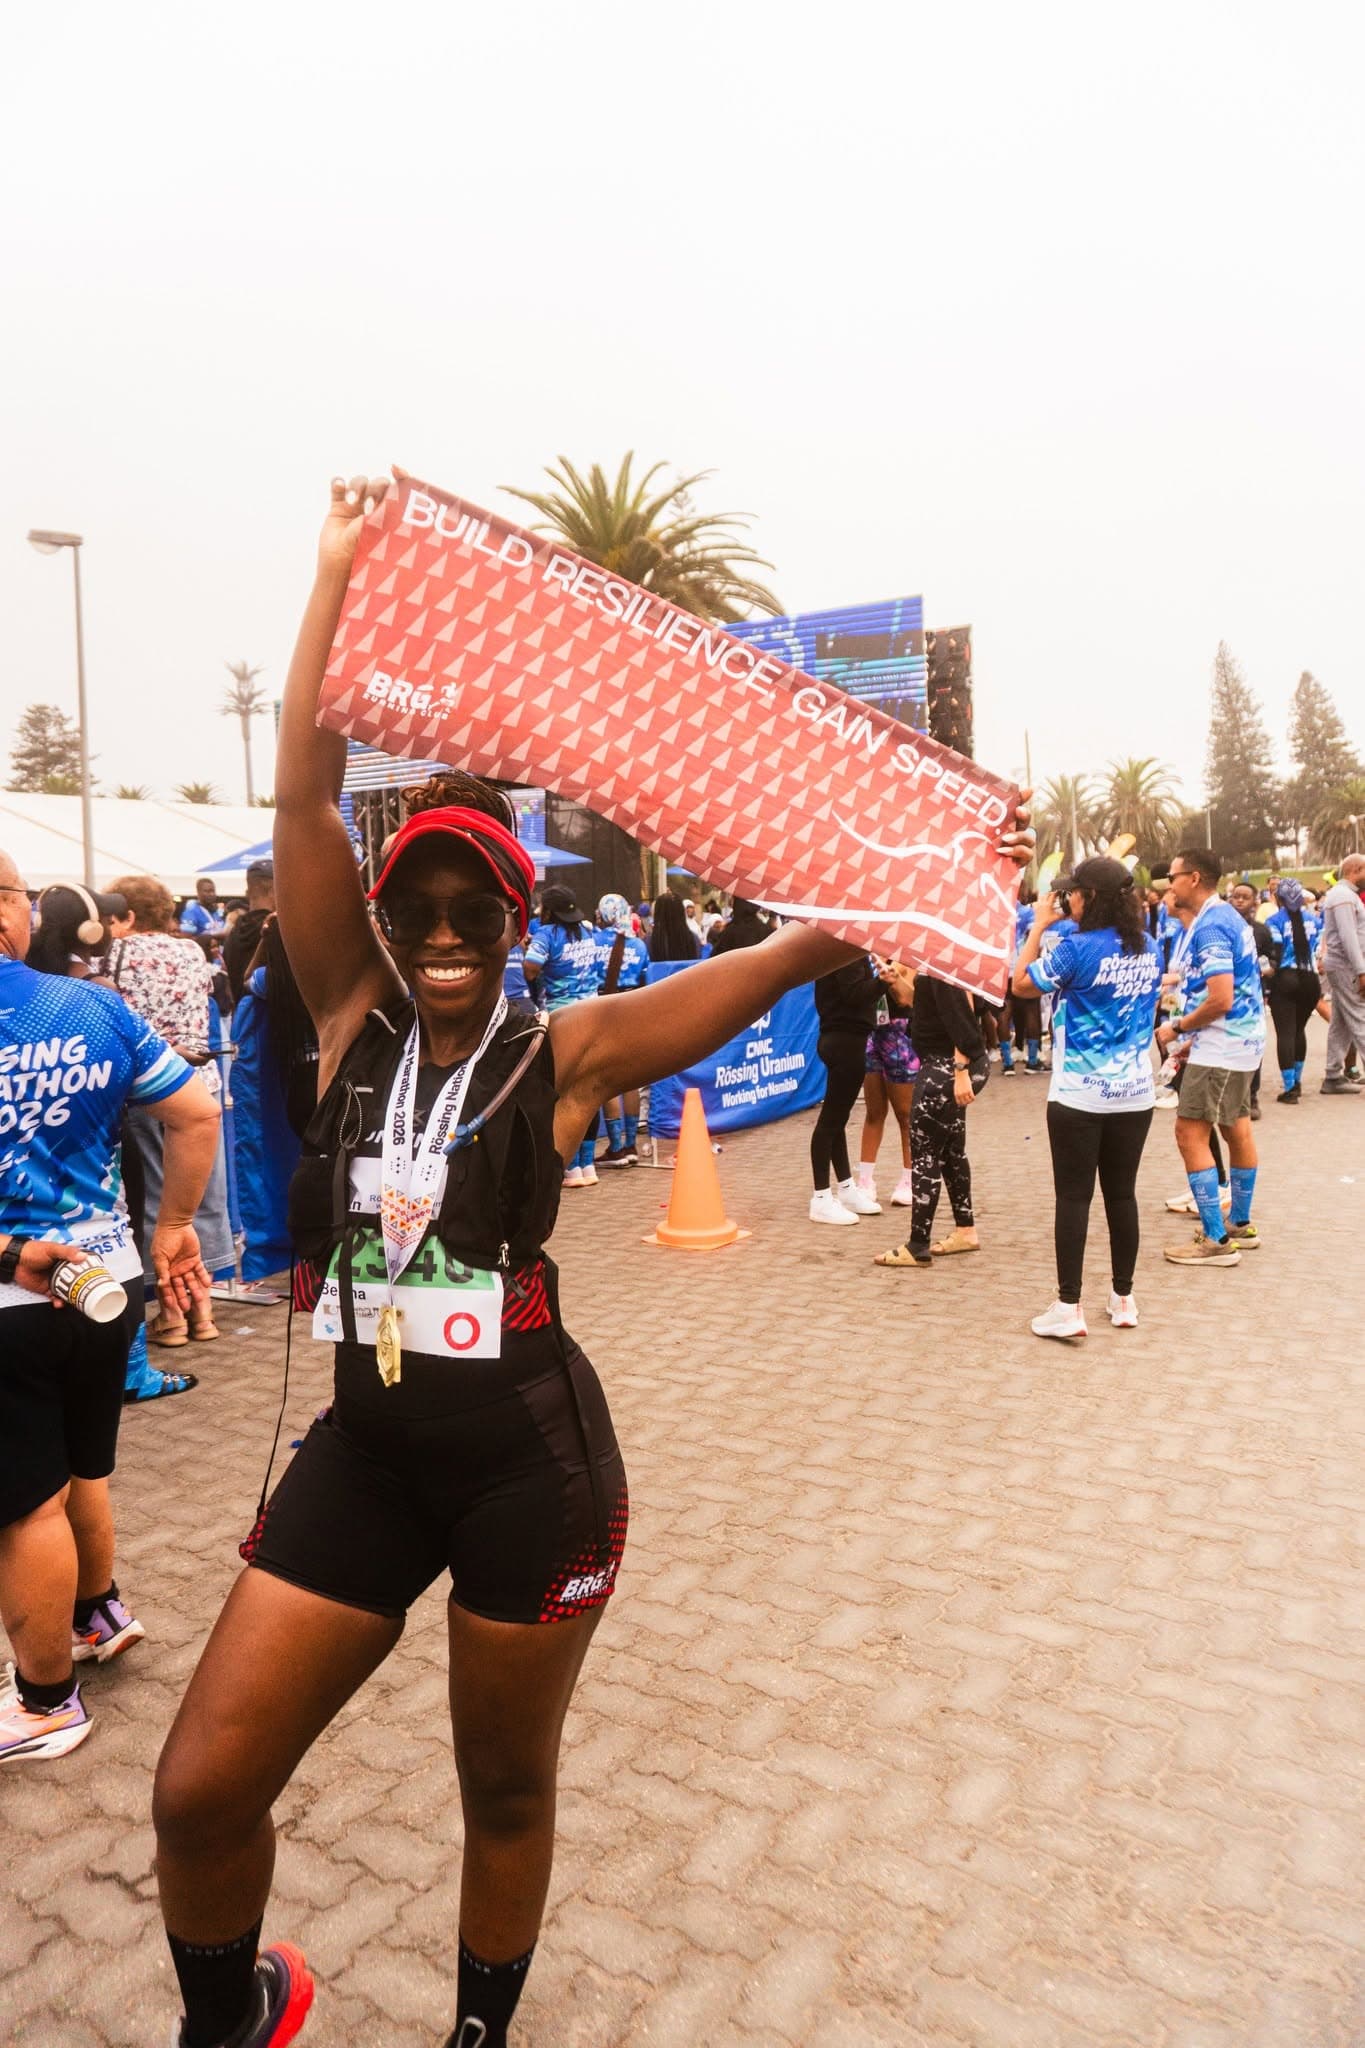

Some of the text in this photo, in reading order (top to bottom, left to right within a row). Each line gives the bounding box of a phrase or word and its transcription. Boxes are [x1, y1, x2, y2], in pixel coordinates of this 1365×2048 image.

[402, 488, 1008, 837] BUILD RESILIENCE. GAIN SPEED.
[362, 692, 450, 720] RUNNING CLUB
[366, 670, 435, 710] BRG
[1112, 979, 1153, 999] 2026
[396, 1056, 416, 1109] Marathon
[715, 1052, 805, 1089] Rössing Uranium
[1083, 1076, 1111, 1090] Body
[722, 1076, 798, 1109] Working for Namibia
[392, 1111, 407, 1147] 2026
[429, 1103, 457, 1155] Rössing
